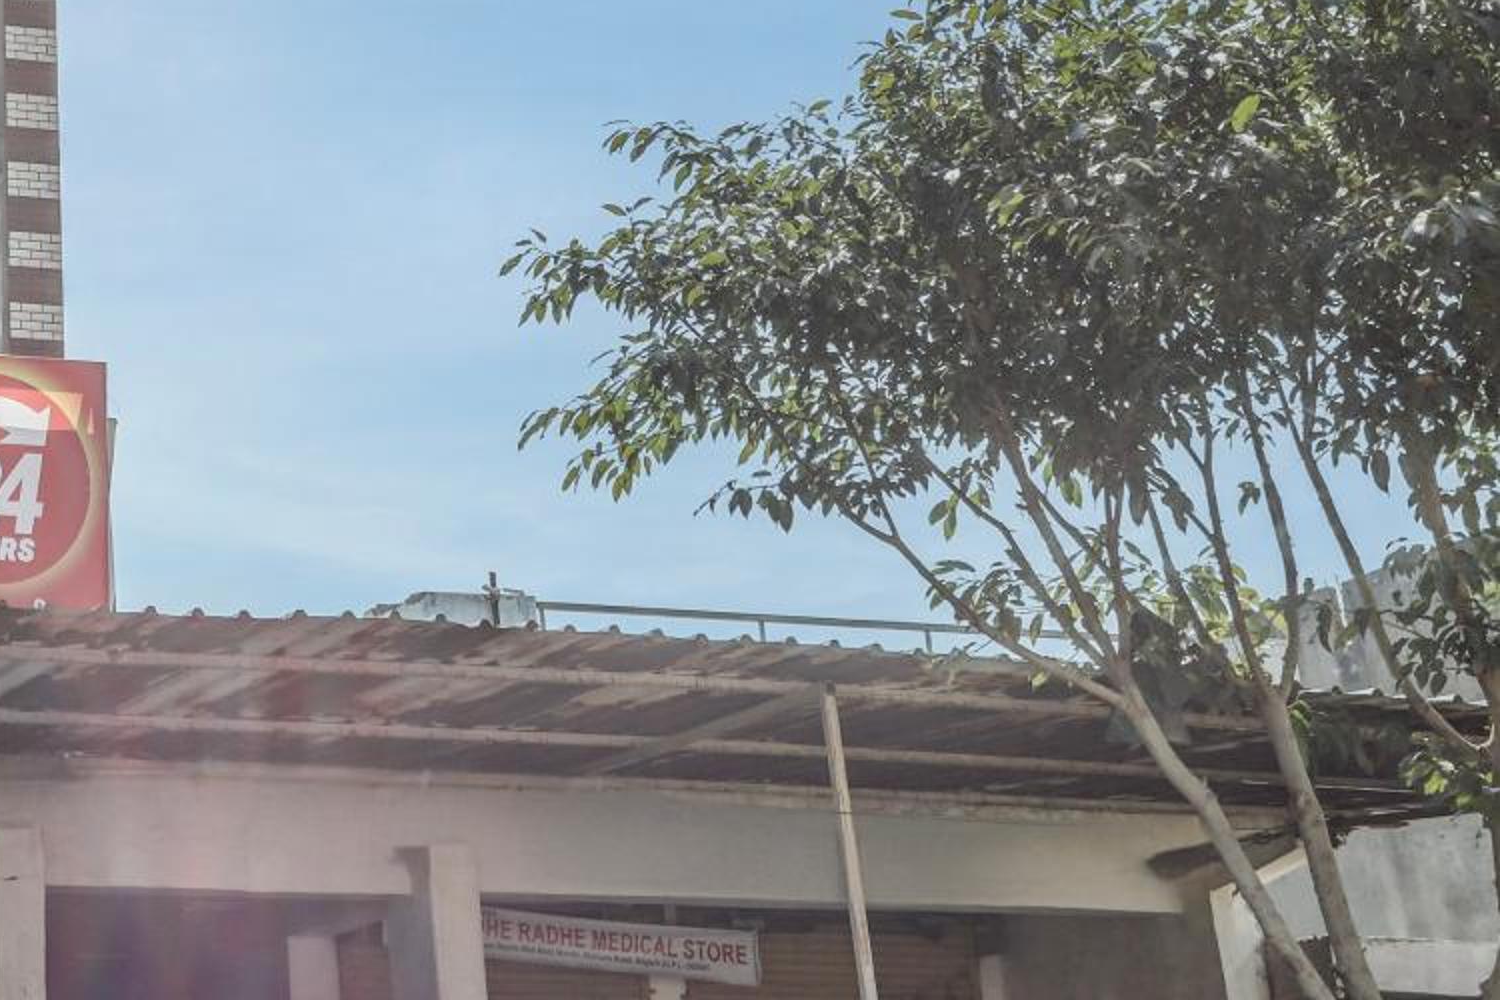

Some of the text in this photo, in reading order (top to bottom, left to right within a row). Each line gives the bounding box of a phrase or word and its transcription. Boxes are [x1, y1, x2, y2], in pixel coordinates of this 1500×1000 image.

[483, 918, 512, 940] HE
[518, 922, 588, 949] RADHE
[592, 929, 677, 959] MEDICAL
[683, 938, 749, 966] STORE
